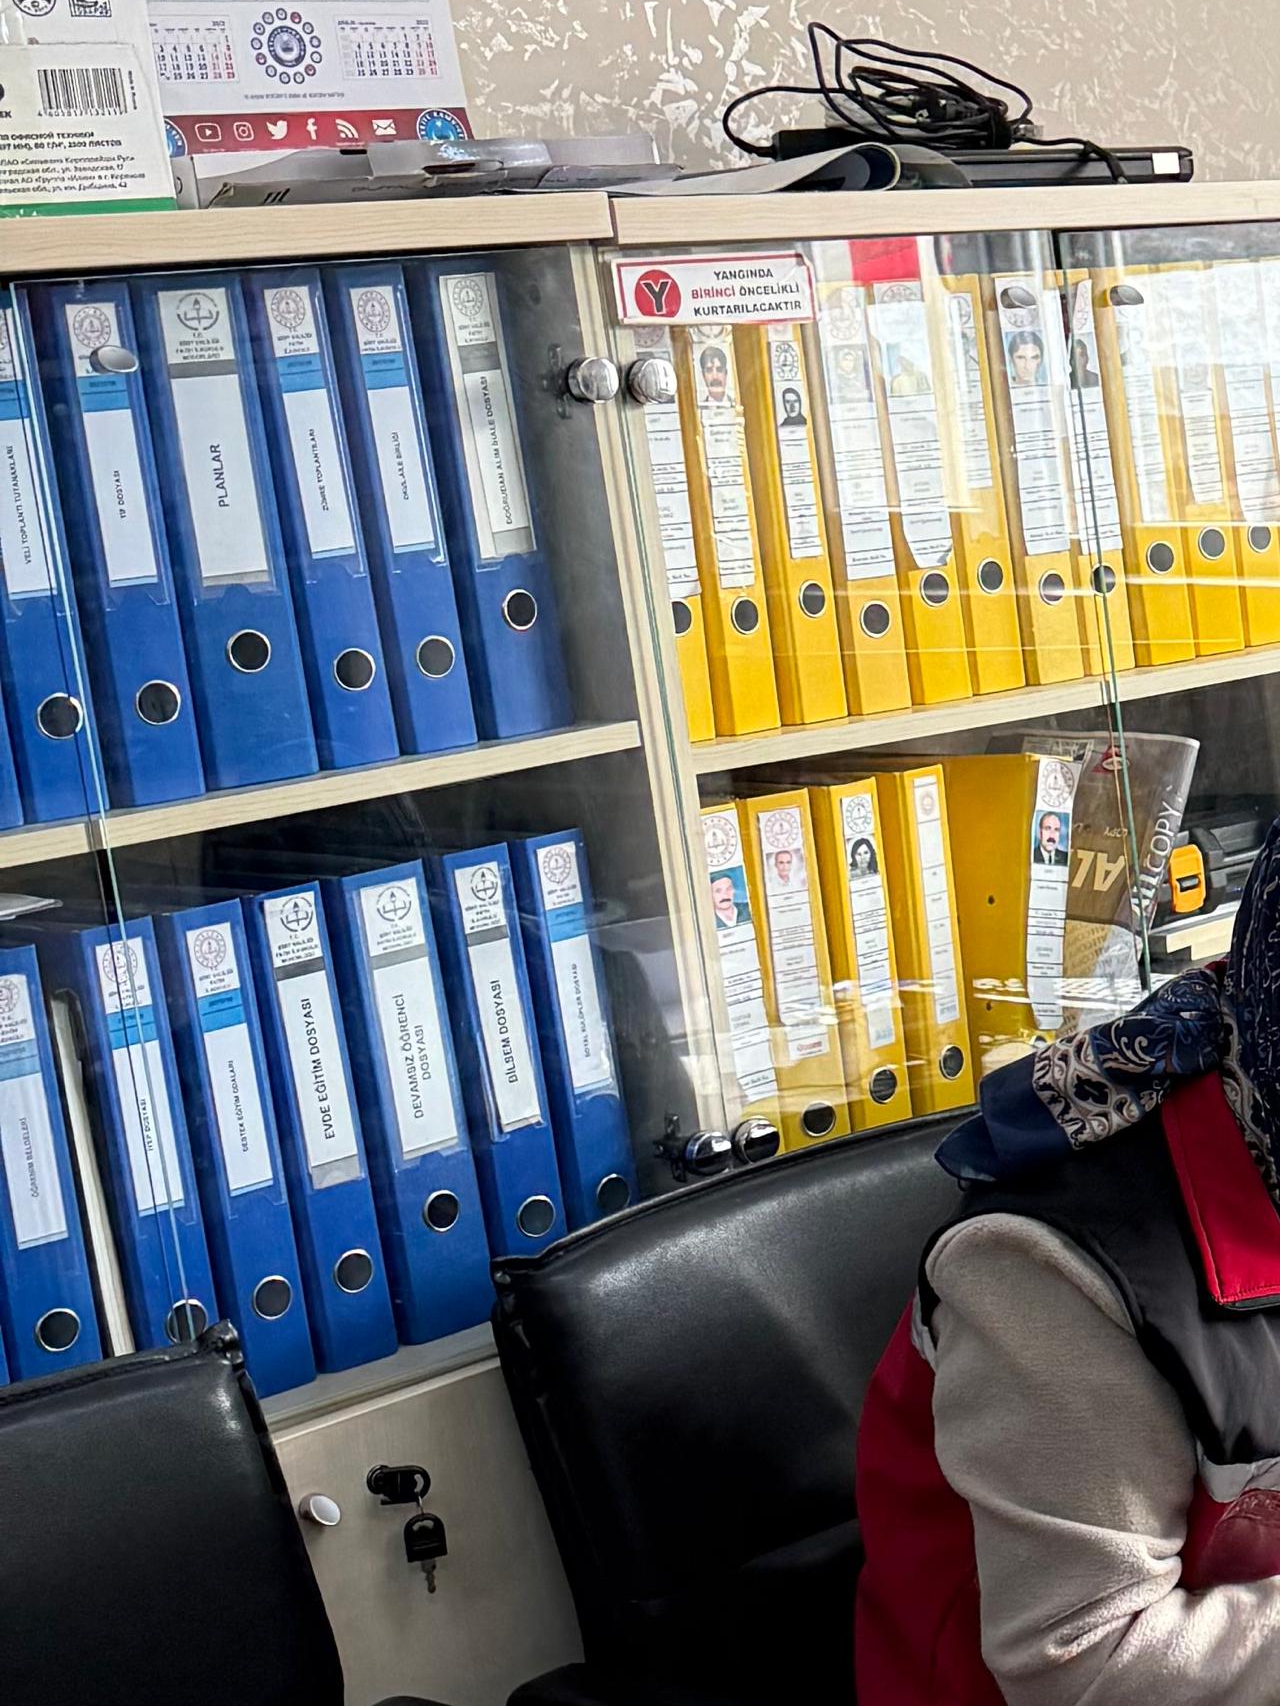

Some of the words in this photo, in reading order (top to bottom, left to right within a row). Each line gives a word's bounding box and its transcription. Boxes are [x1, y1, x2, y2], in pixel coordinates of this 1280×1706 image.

[691, 285, 736, 300] BİRİNCİ
[738, 283, 800, 298] ÖNCELİKLİ
[713, 268, 773, 281] YANGINDA
[693, 300, 802, 317] KURTARILACAKTIR
[209, 444, 230, 508] PLANLAR
[300, 997, 321, 1055] DOSYASI
[393, 994, 413, 1053] ÖĞRENCİ
[489, 979, 509, 1036] DOSYASI
[310, 1056, 328, 1102] EĞİTİM
[414, 1024, 432, 1081] DOSYASI
[404, 1056, 424, 1120] DEVAMSIZ
[318, 1103, 335, 1140] EVDE
